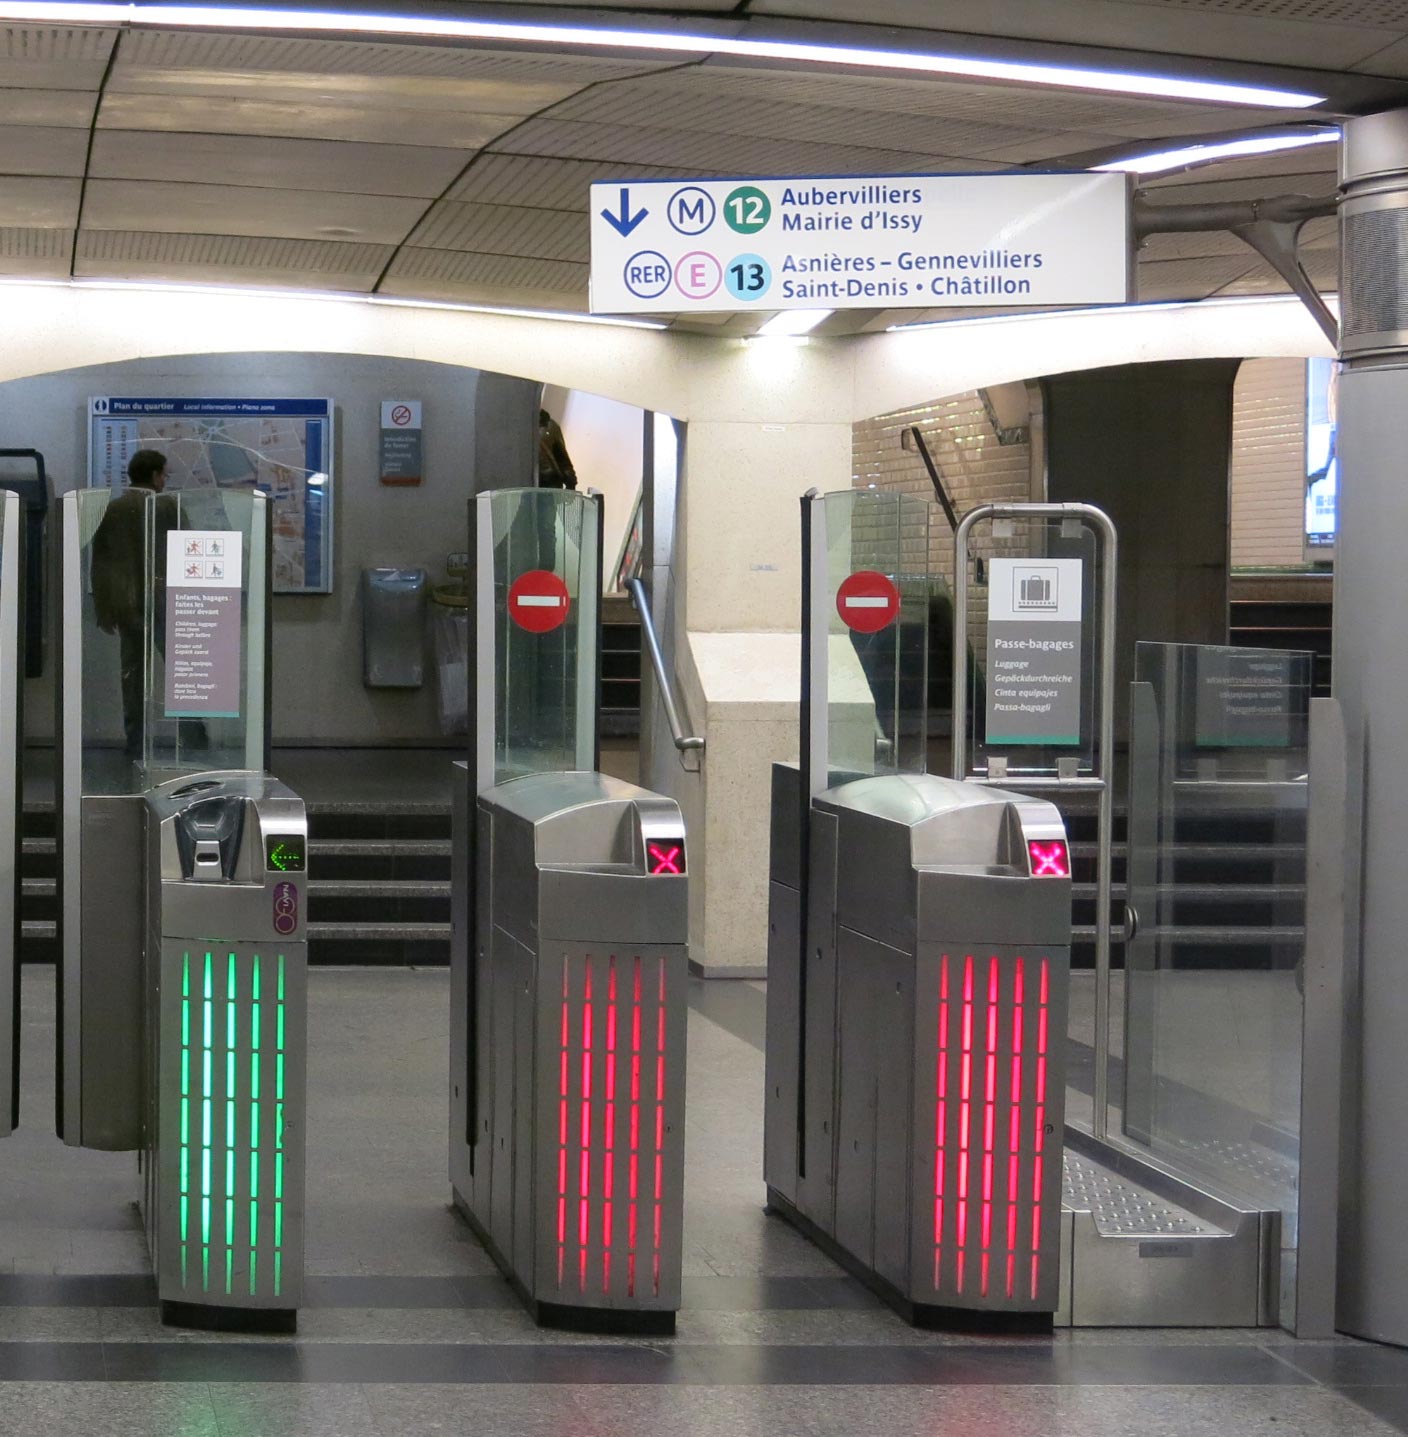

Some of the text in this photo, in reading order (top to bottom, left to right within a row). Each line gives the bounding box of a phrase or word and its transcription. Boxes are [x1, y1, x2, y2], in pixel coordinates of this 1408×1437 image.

[782, 187, 922, 207] Aubervilliers
[678, 200, 705, 224] M
[729, 197, 764, 225] 12
[782, 210, 923, 233] Mairie d’Issy
[782, 254, 875, 273] Asnières
[897, 250, 1043, 271] Gennevilliers
[632, 266, 666, 284] RER
[691, 264, 705, 287] E
[730, 264, 764, 291] 13
[782, 279, 908, 299] Saint-Denis
[930, 276, 1031, 296] Châtillon
[114, 402, 175, 412] Plan du quartier
[202, 594, 229, 602] bagages
[994, 638, 1075, 651] Passe-bagages
[994, 660, 1030, 669] Luggage
[994, 674, 1073, 684] Gepäckdurchreiche
[994, 688, 1058, 698] Cinta equipajes
[994, 703, 1051, 713] Passa-bagagli
